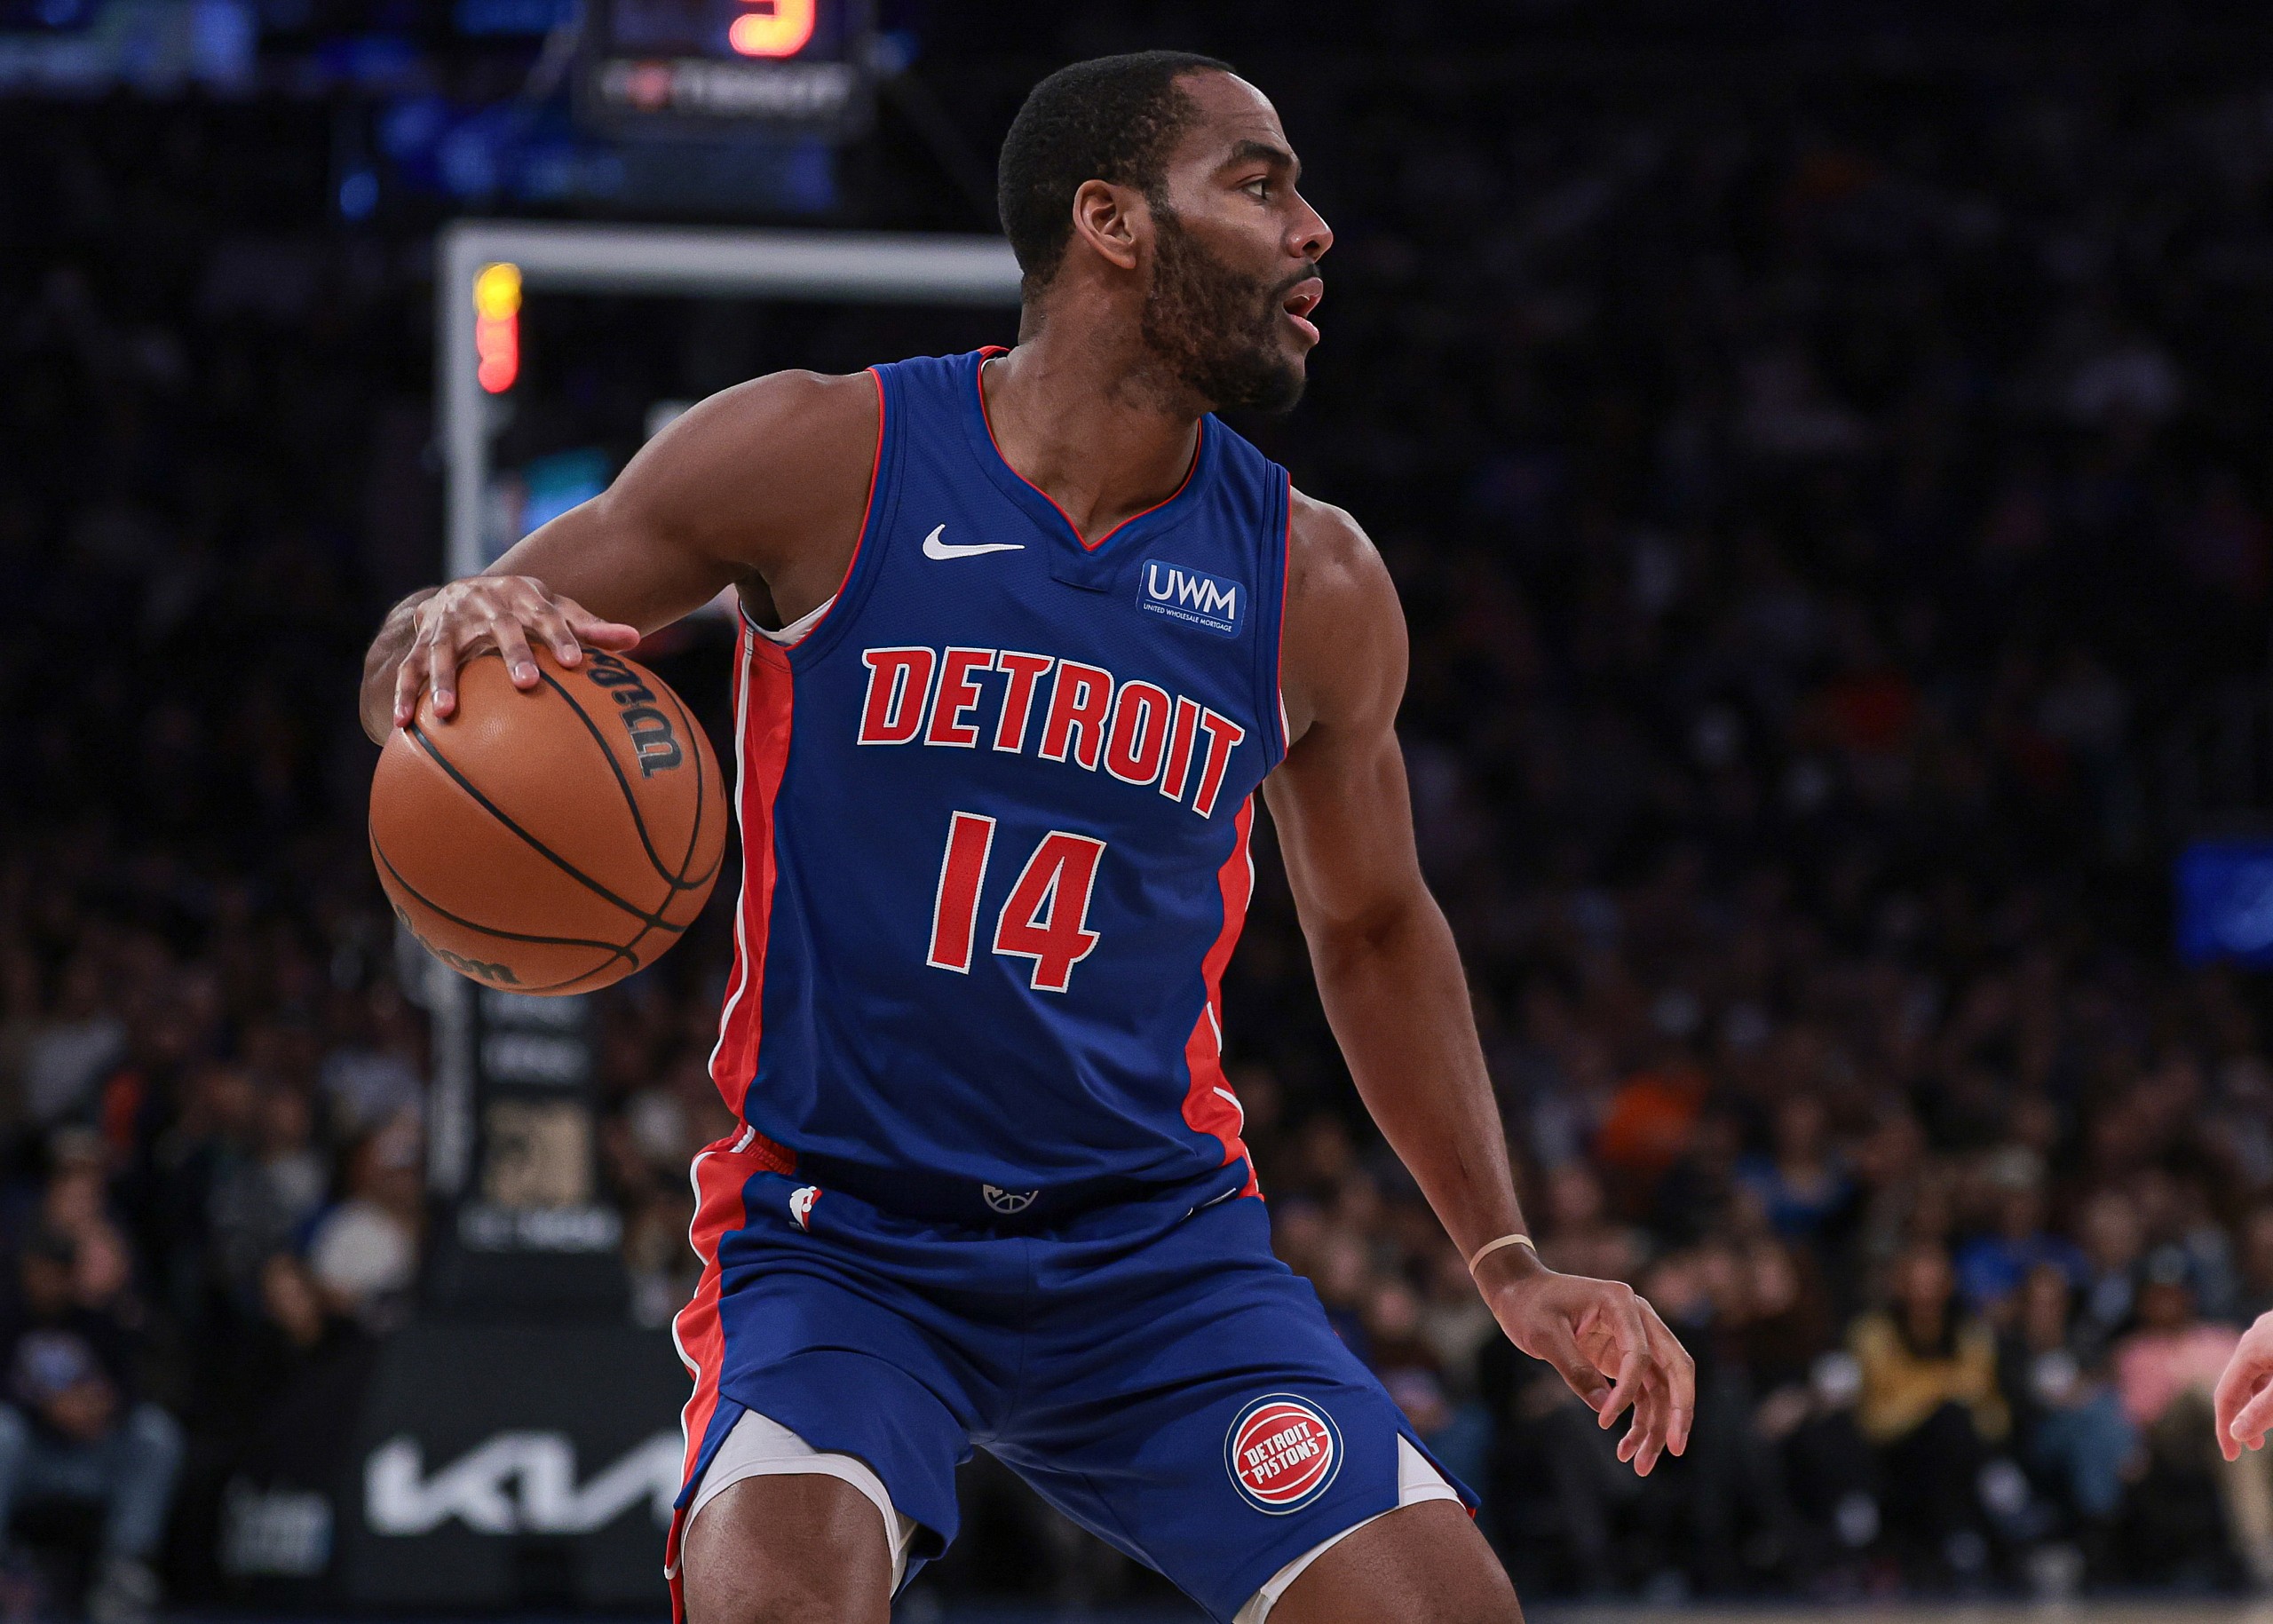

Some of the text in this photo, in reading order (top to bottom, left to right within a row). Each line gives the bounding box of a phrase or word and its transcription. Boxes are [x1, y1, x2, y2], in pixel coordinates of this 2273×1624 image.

[1143, 603, 1232, 633] UNITED WHOLESALE MORTGAGE
[1148, 564, 1236, 621] UWM
[857, 646, 1245, 820] DETROIT
[926, 810, 1106, 993] 14
[1243, 1422, 1311, 1467] DETROIT
[1251, 1437, 1320, 1485] PISTONS
